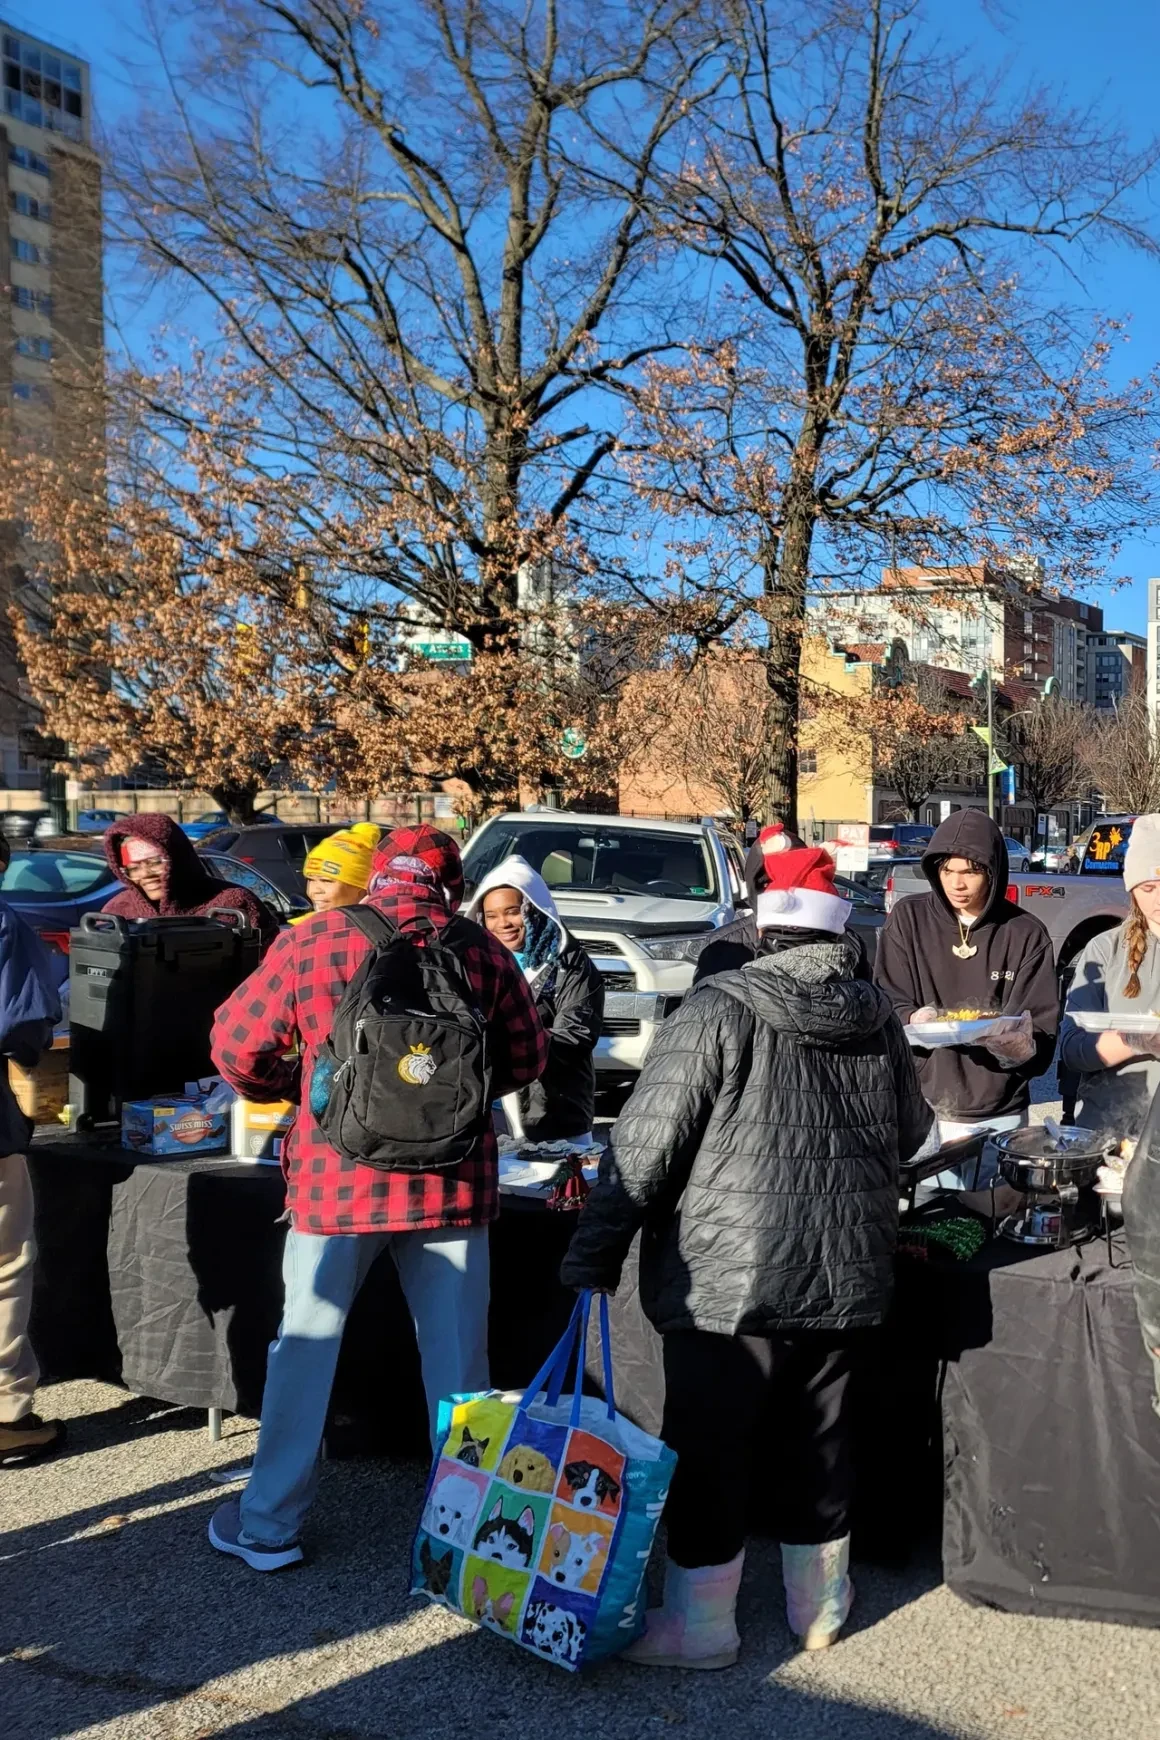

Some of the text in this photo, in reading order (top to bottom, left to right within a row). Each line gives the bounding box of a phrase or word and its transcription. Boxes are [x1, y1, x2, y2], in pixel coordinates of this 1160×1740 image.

[1025, 885, 1066, 897] FX4
[169, 1119, 213, 1133] SWISS MISS
